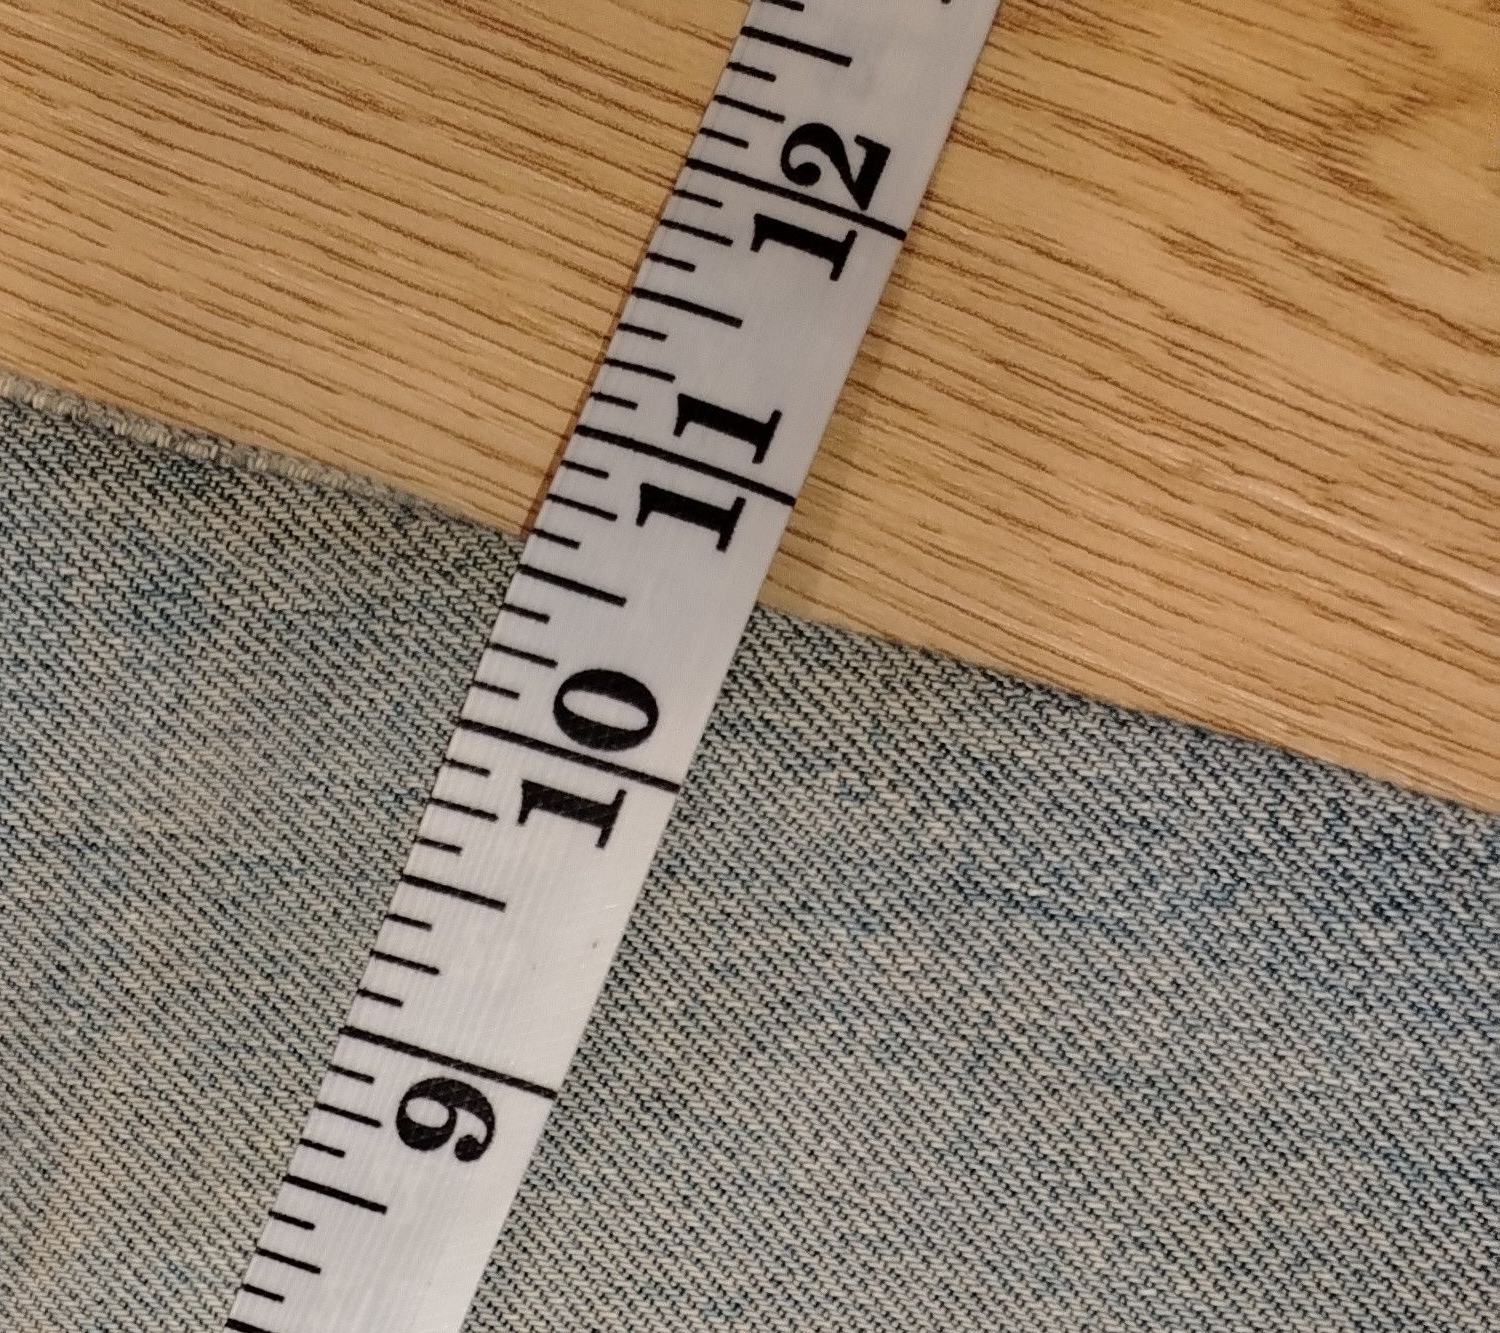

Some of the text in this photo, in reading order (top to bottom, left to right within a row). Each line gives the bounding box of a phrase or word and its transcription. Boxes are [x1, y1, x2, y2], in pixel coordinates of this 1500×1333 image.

[751, 122, 890, 281] 12
[636, 394, 782, 552] 11
[517, 669, 659, 849] 10
[395, 1076, 496, 1162] 9
